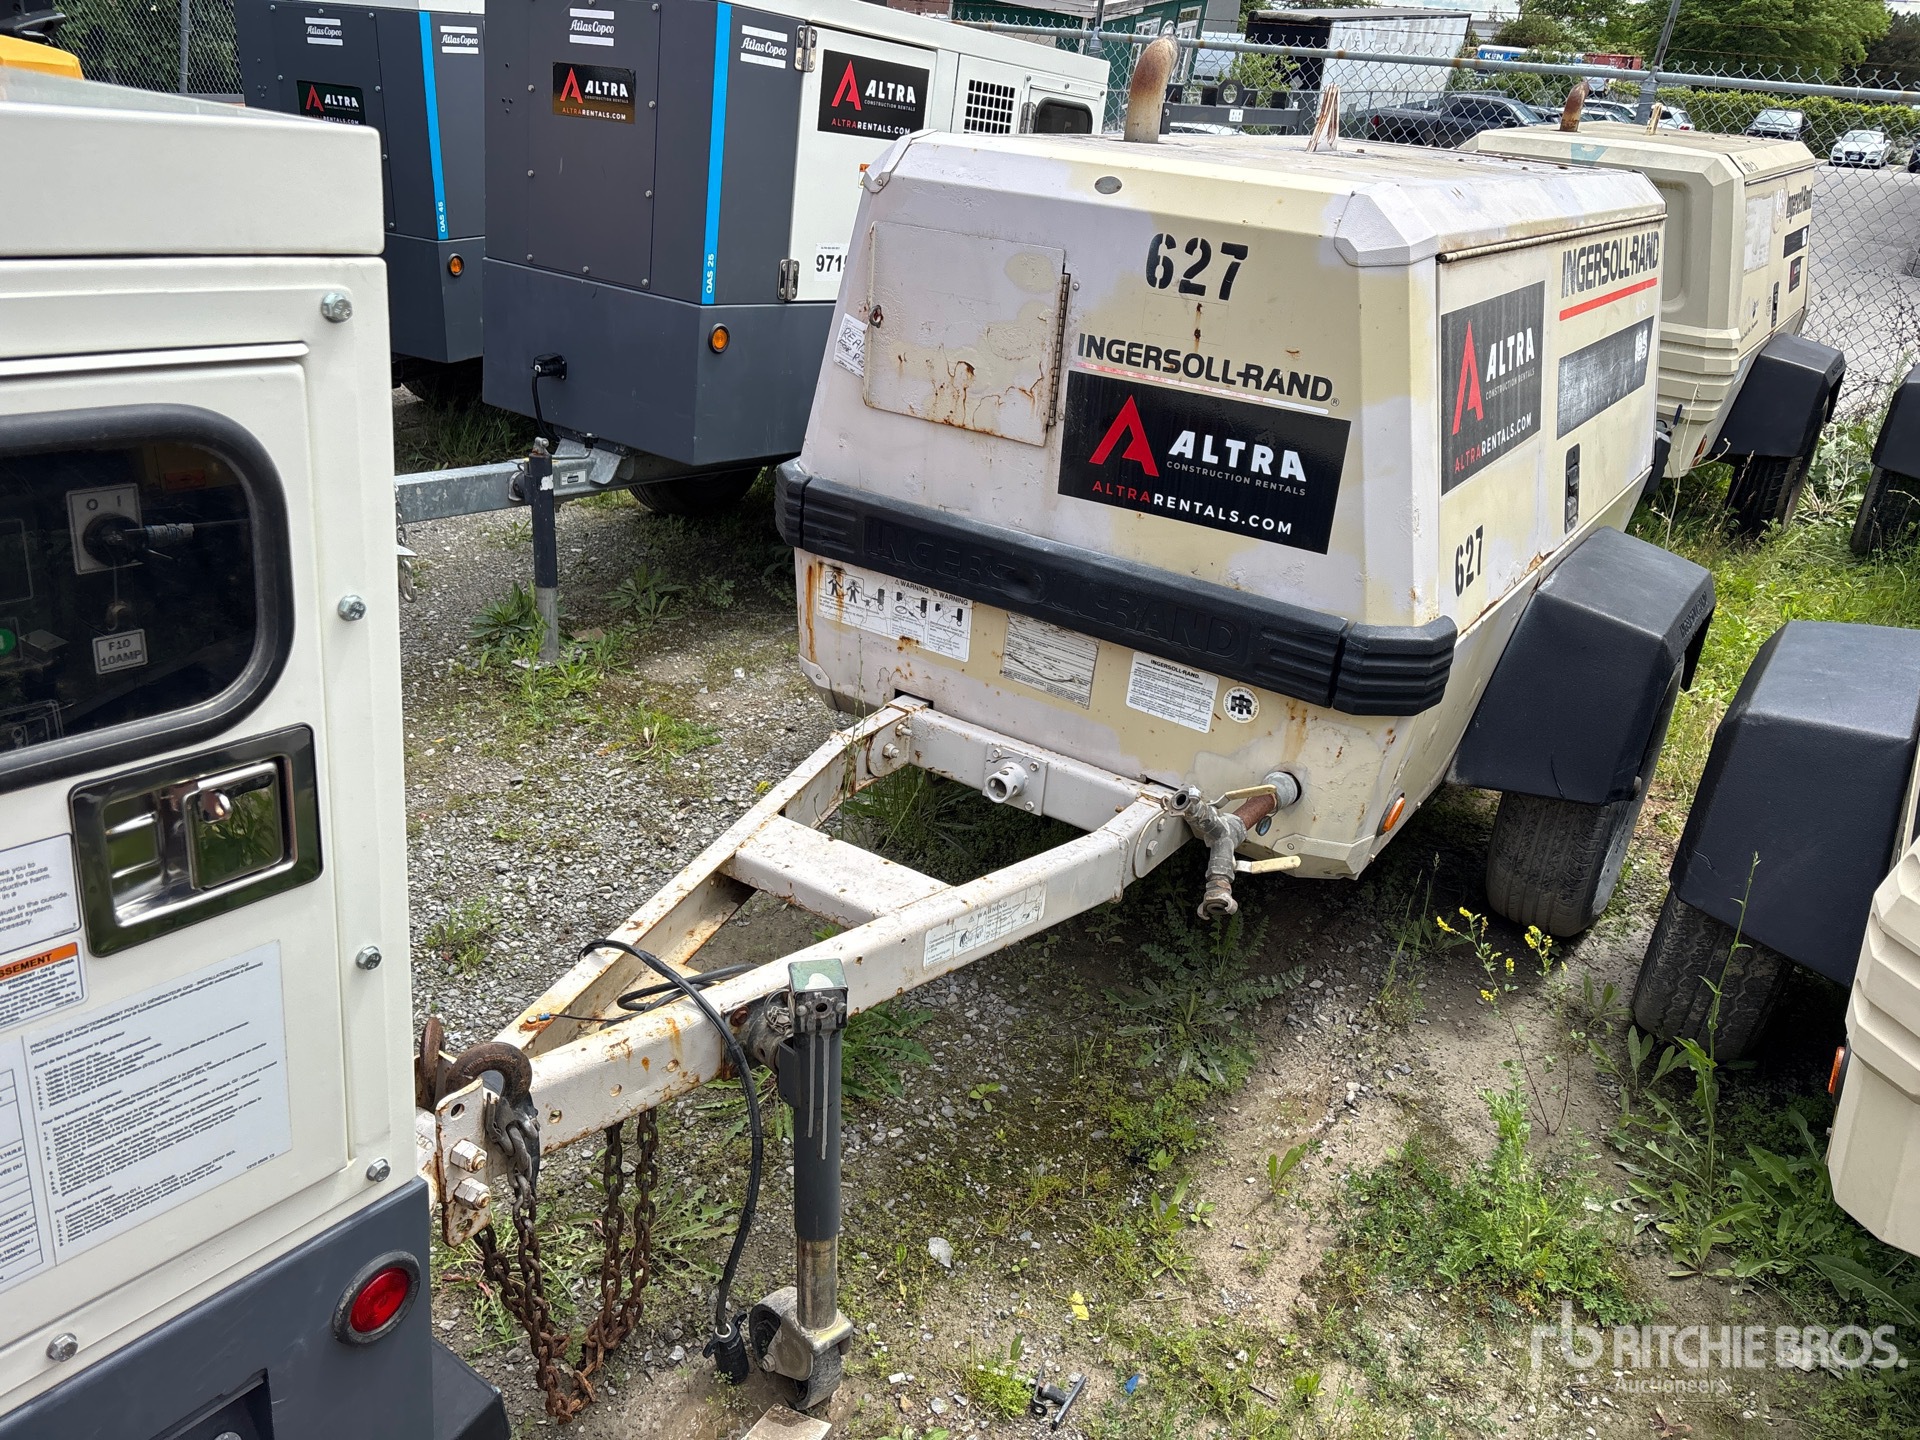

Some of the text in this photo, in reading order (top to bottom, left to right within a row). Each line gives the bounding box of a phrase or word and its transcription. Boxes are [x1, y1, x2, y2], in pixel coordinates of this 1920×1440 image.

[324, 94, 359, 108] ALTRA
[584, 80, 629, 98] ALTRA
[865, 79, 916, 104] ALTRA
[562, 107, 626, 120] ALTRARENTALS.COM
[831, 118, 911, 136] ALTRARENTALS.COM
[815, 254, 848, 273] 971
[1146, 233, 1249, 301] 627
[1561, 231, 1659, 299] INGERSOLL-RAND
[1077, 333, 1334, 403] INGERSOLL-RAND
[1485, 327, 1535, 384] ALTRA
[1485, 368, 1535, 401] CONSTRUCTION RENTALS
[1168, 430, 1308, 482] ALTRA
[1454, 411, 1533, 475] ALTRARENTALS.COM
[1166, 461, 1306, 497] CONSTRUCTION RENTALS
[1092, 480, 1293, 535] ALTRARENTALS.COM
[1455, 525, 1484, 597] 627
[901, 580, 930, 595] WARNING
[938, 591, 969, 606] WARNING
[101, 649, 143, 667] 10AMP
[108, 639, 131, 651] F10
